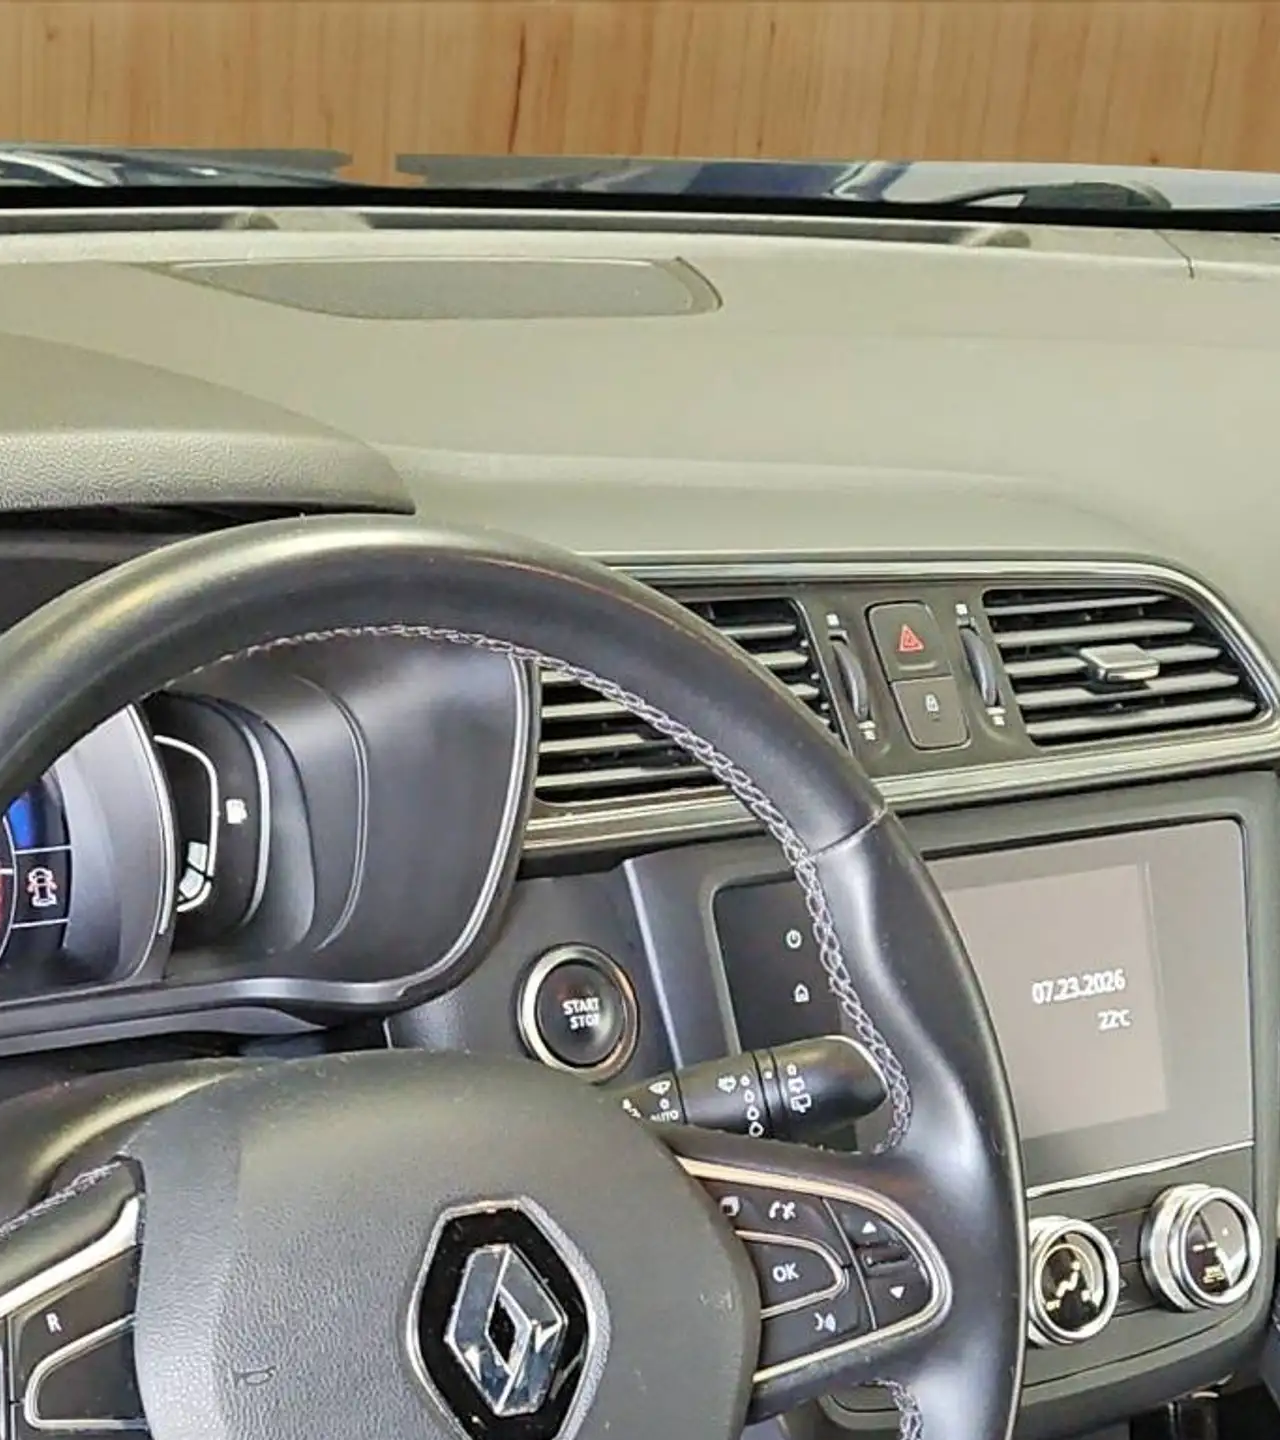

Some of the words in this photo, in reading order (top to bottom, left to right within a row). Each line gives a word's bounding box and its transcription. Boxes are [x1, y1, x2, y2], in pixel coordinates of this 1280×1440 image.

[1032, 968, 1126, 1004] 07.23.2026
[562, 997, 600, 1015] START
[772, 1262, 800, 1283] OK
[46, 1312, 62, 1333] R
